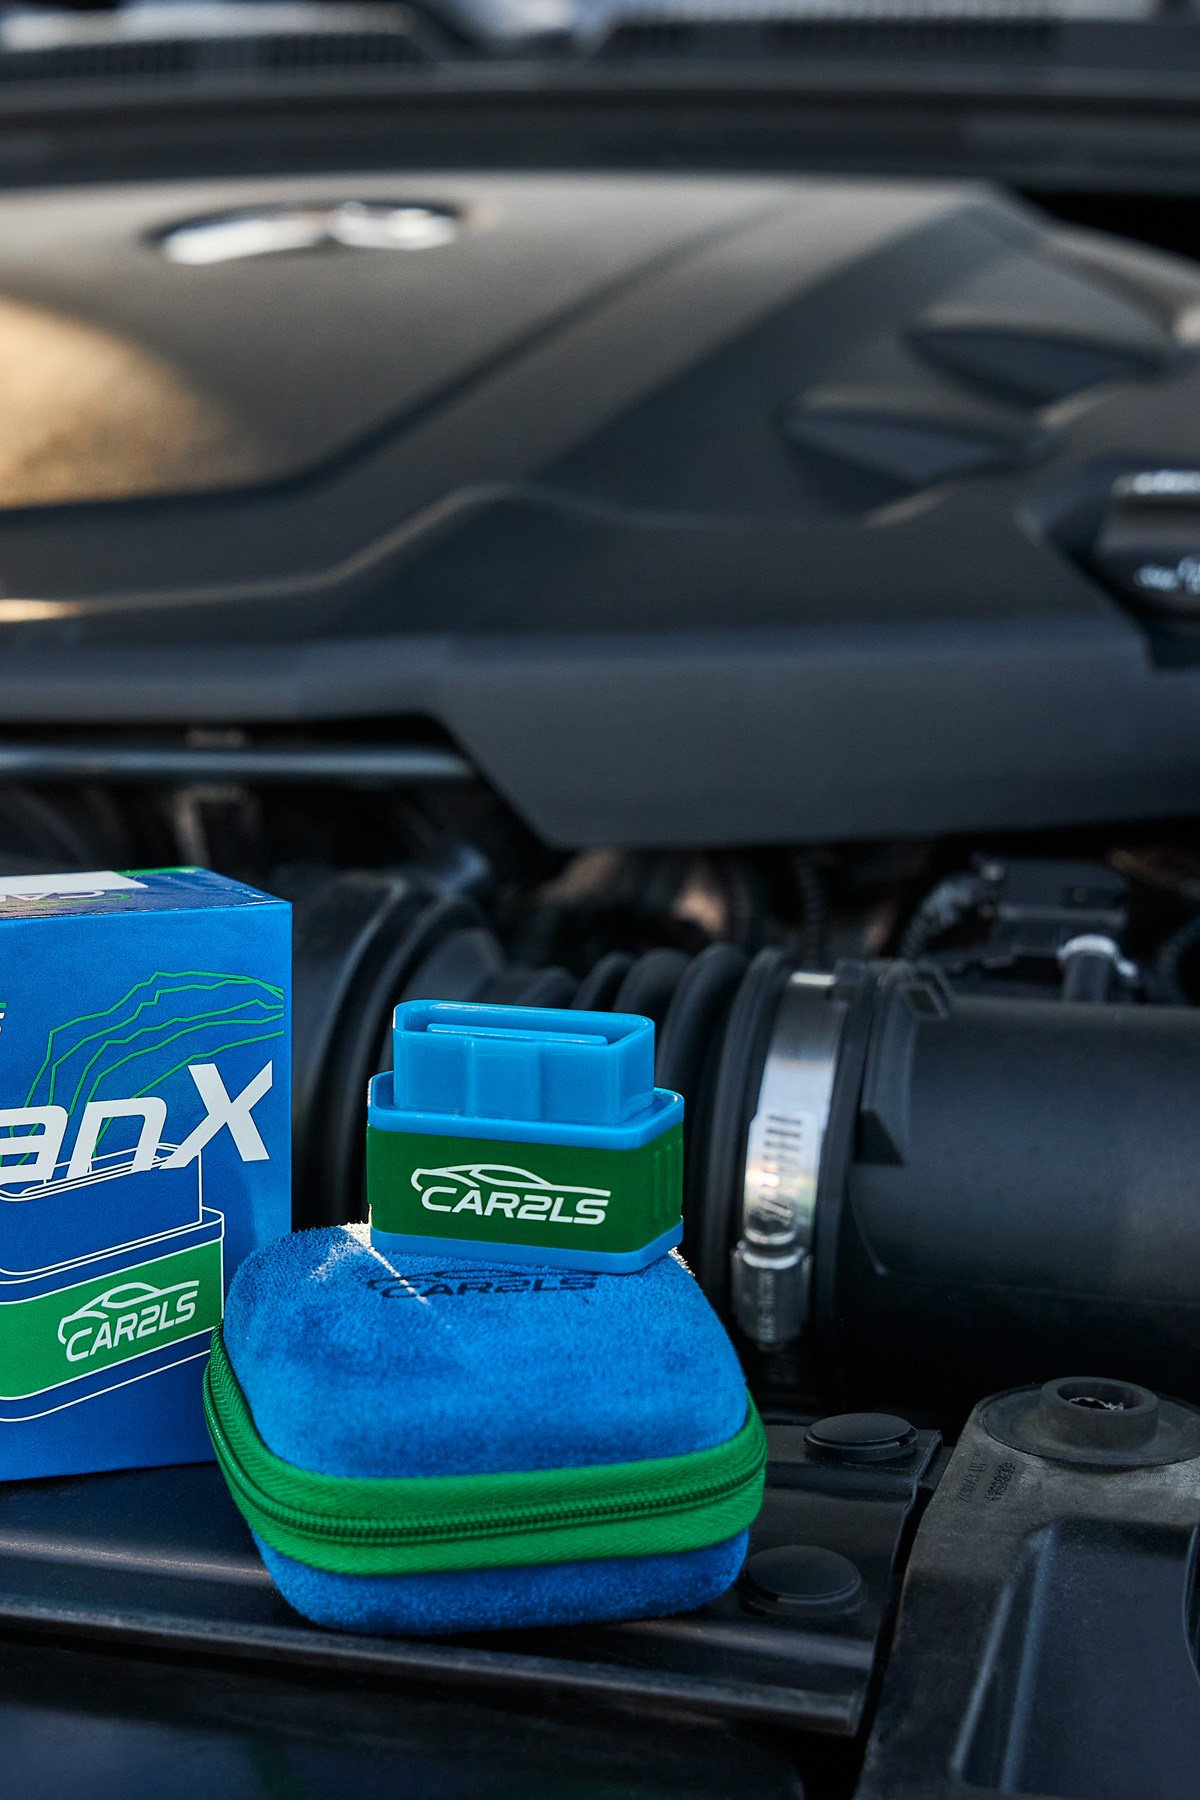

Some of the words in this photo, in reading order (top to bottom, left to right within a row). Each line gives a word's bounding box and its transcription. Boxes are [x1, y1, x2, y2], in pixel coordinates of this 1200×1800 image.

[422, 1186, 609, 1225] CAR2LS
[381, 1277, 598, 1299] CAR2LS
[66, 1290, 198, 1362] CAR2LS
